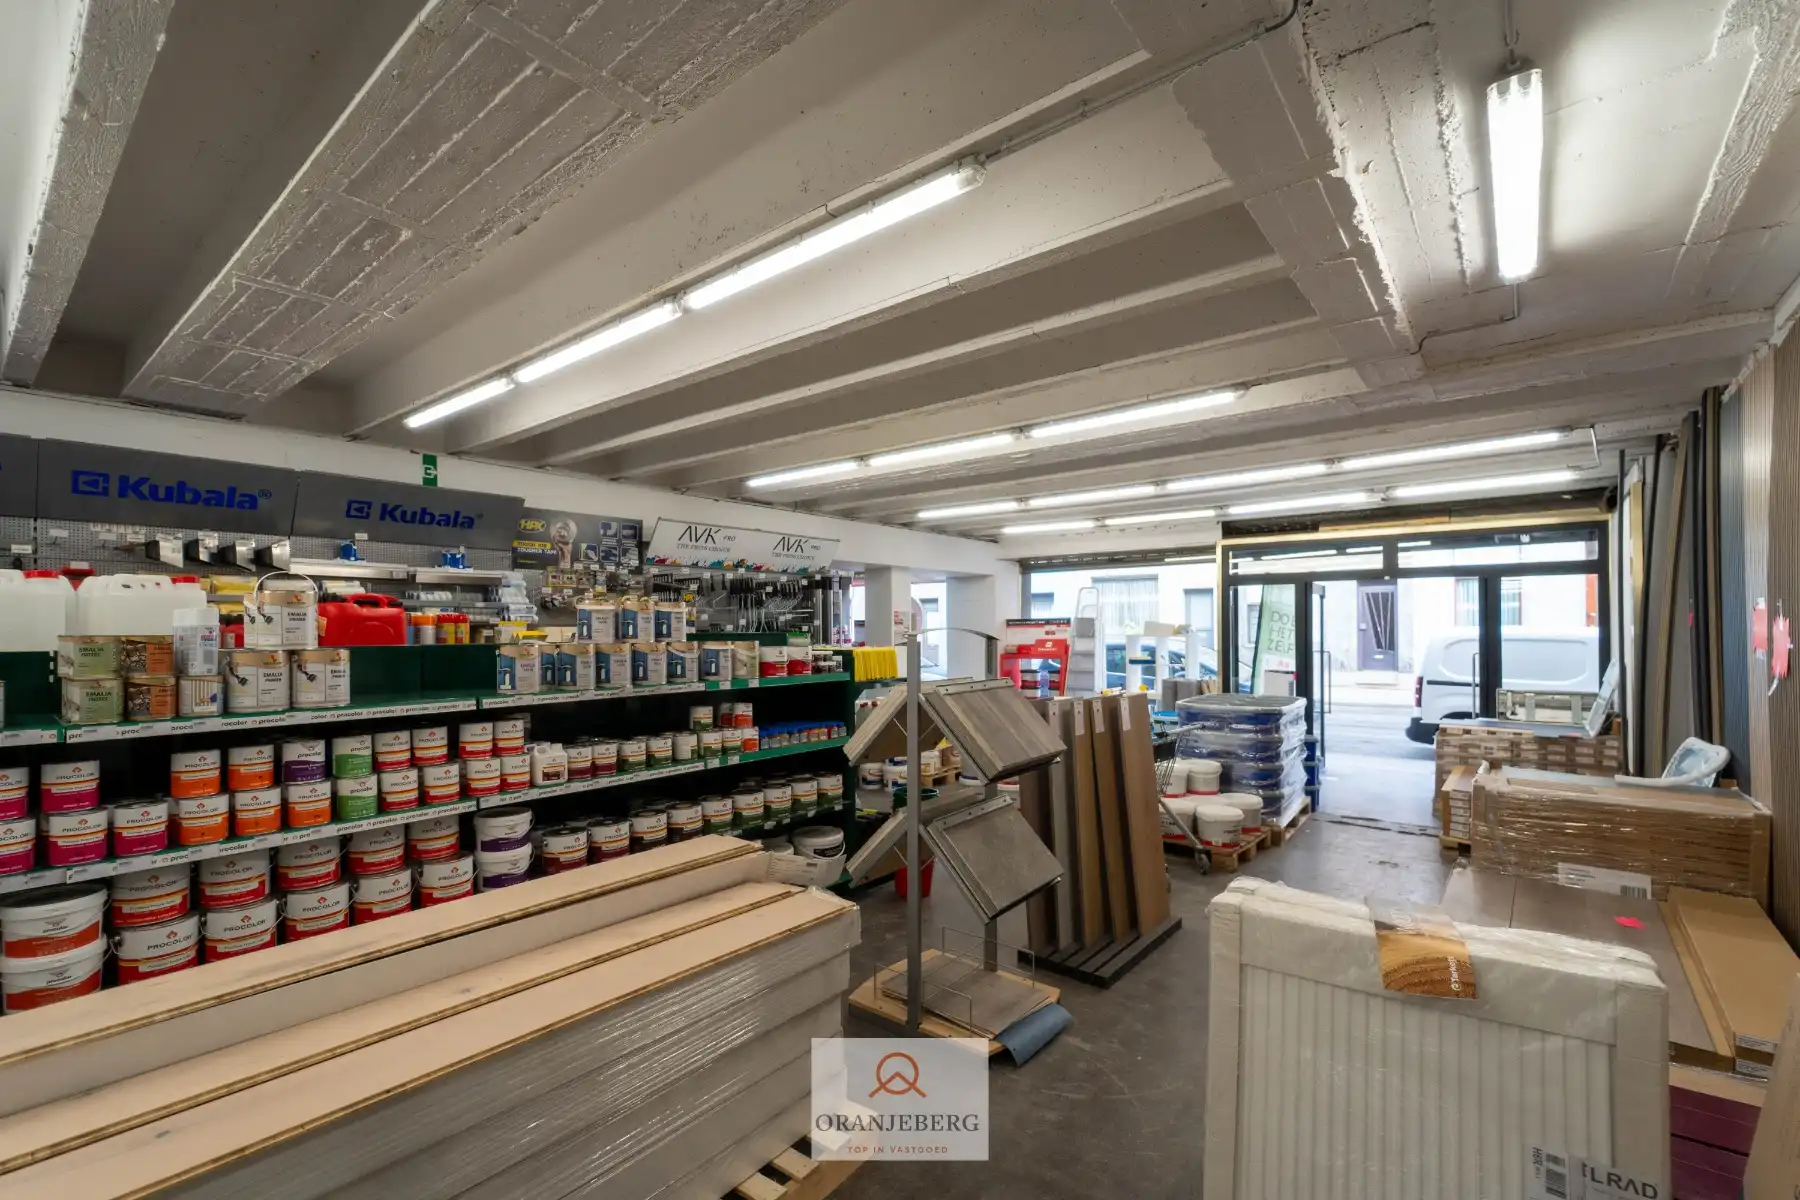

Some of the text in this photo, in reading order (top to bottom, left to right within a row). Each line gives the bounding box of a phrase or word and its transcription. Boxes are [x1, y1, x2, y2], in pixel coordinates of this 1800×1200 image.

[1270, 624, 1295, 639] HET
[1267, 638, 1294, 654] ZELF
[336, 710, 363, 719] procolor
[126, 815, 163, 824] PROCOLOR
[336, 823, 363, 833] procolor
[372, 817, 398, 827] procolor
[62, 824, 102, 832] PROCOLOR
[294, 849, 332, 860] PROCOLOR
[210, 866, 253, 877] PROCOLOR
[129, 879, 177, 892] PROCOLOR
[302, 900, 340, 913] PROCOLOR
[223, 919, 266, 933] PROCOLOR
[147, 934, 192, 951] PROCOLOR
